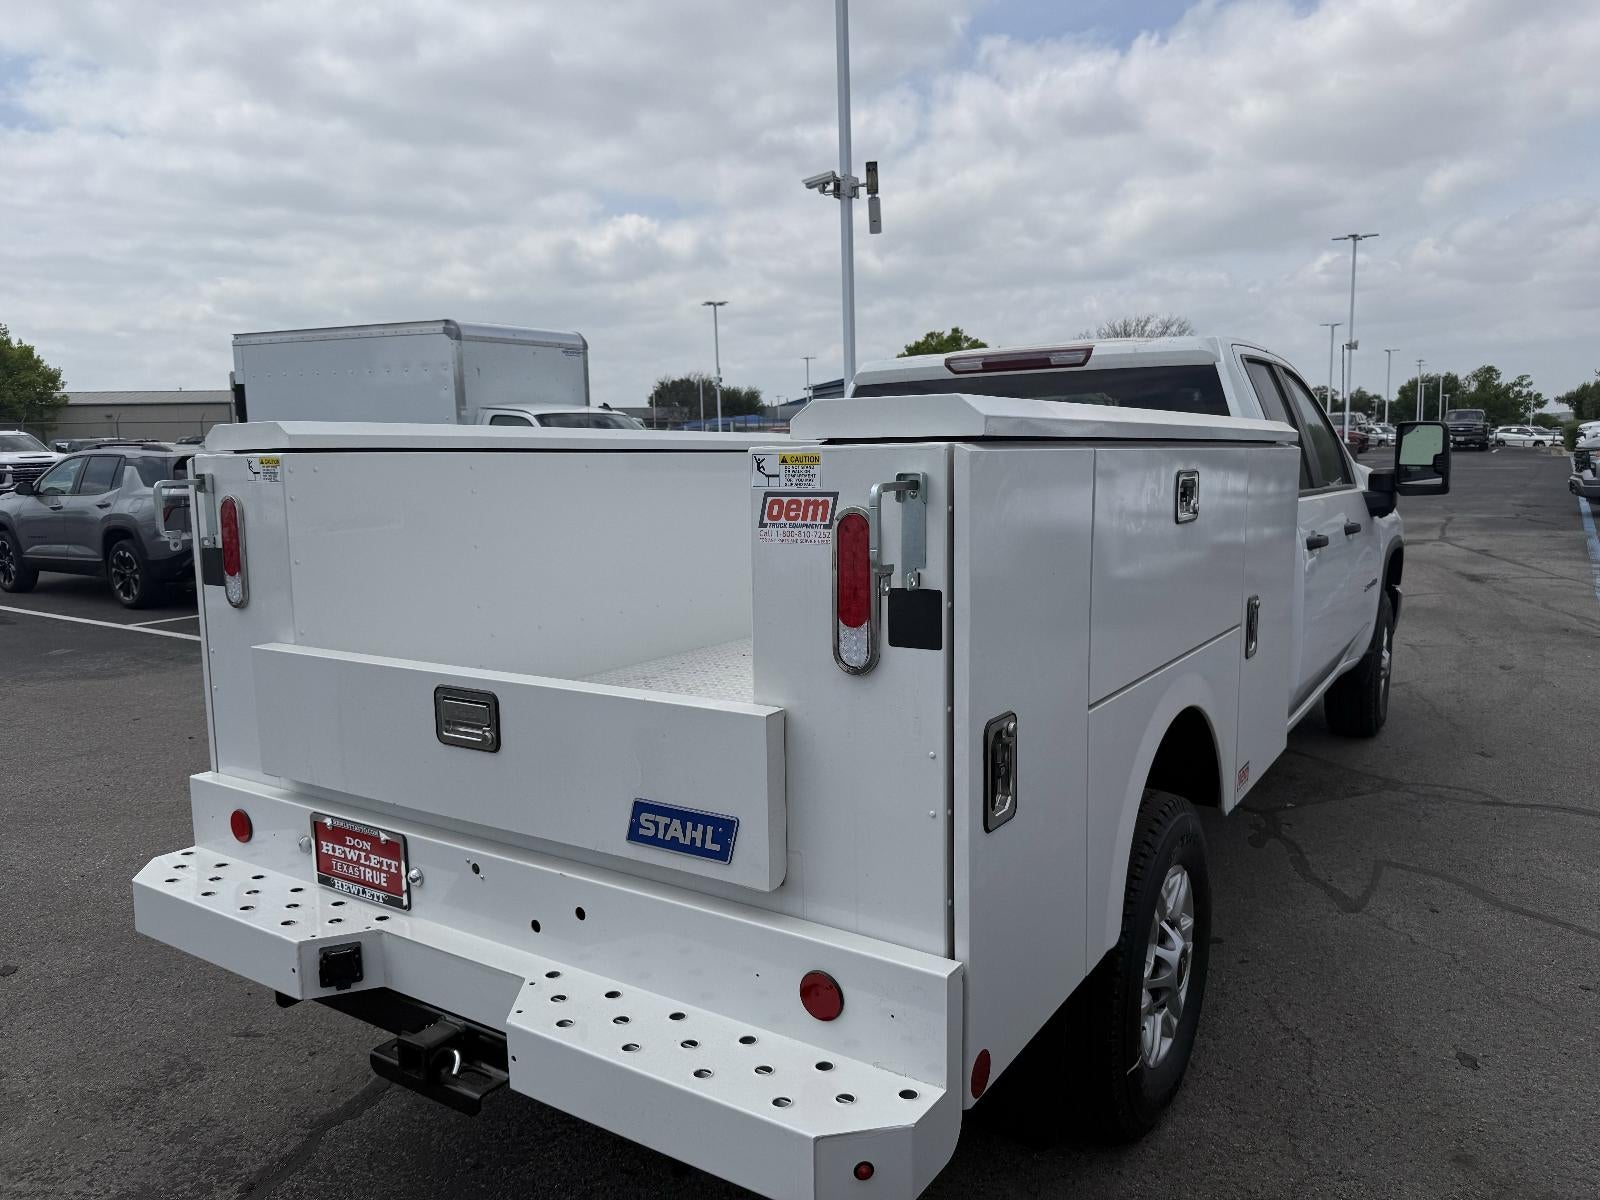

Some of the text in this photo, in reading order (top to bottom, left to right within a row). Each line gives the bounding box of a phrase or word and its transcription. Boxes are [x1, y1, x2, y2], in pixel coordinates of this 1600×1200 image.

[790, 455, 820, 463] CAUTION
[766, 498, 830, 522] oem
[345, 836, 372, 850] DON
[638, 812, 721, 852] STAHL
[320, 841, 398, 874] HEWLETT
[333, 879, 384, 904] HEWLETT
